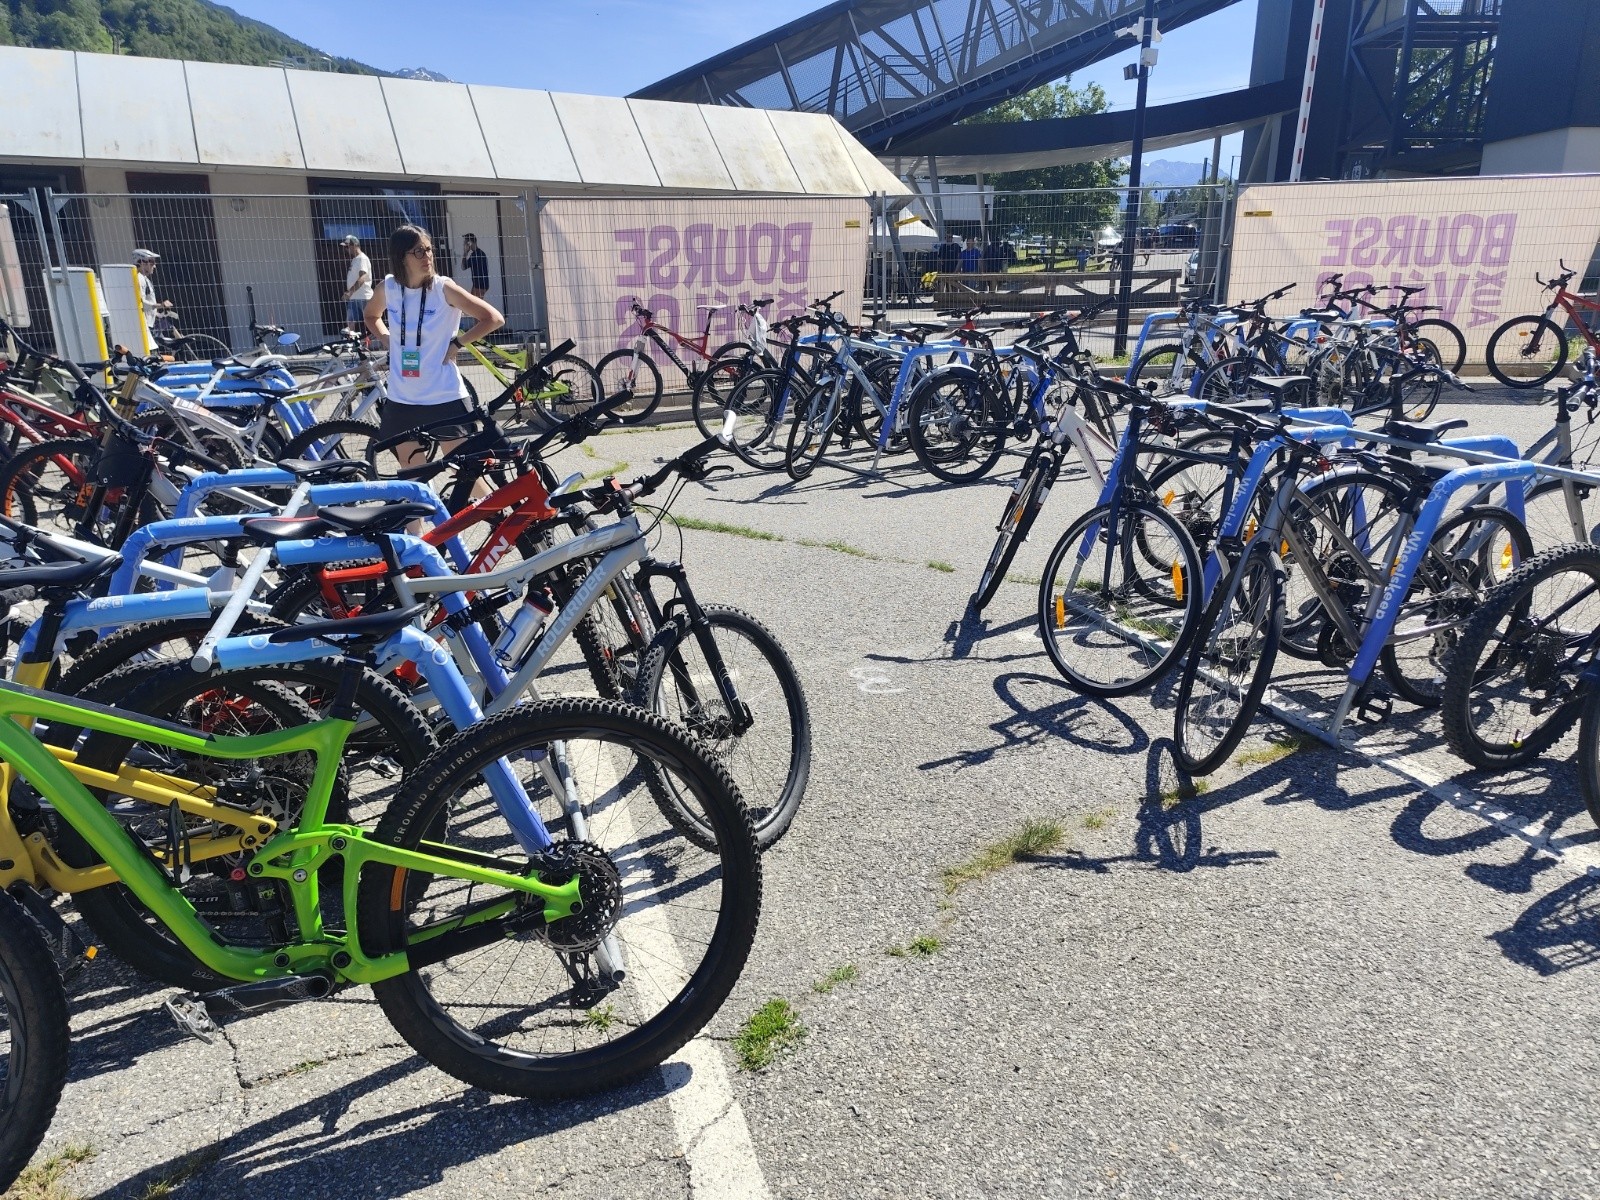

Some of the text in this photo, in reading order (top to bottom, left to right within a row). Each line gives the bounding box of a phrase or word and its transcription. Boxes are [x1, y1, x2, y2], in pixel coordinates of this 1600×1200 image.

[1375, 530, 1425, 620] Wheelskeep
[393, 793, 428, 843] GROUND
[428, 747, 481, 791] CONTROL
